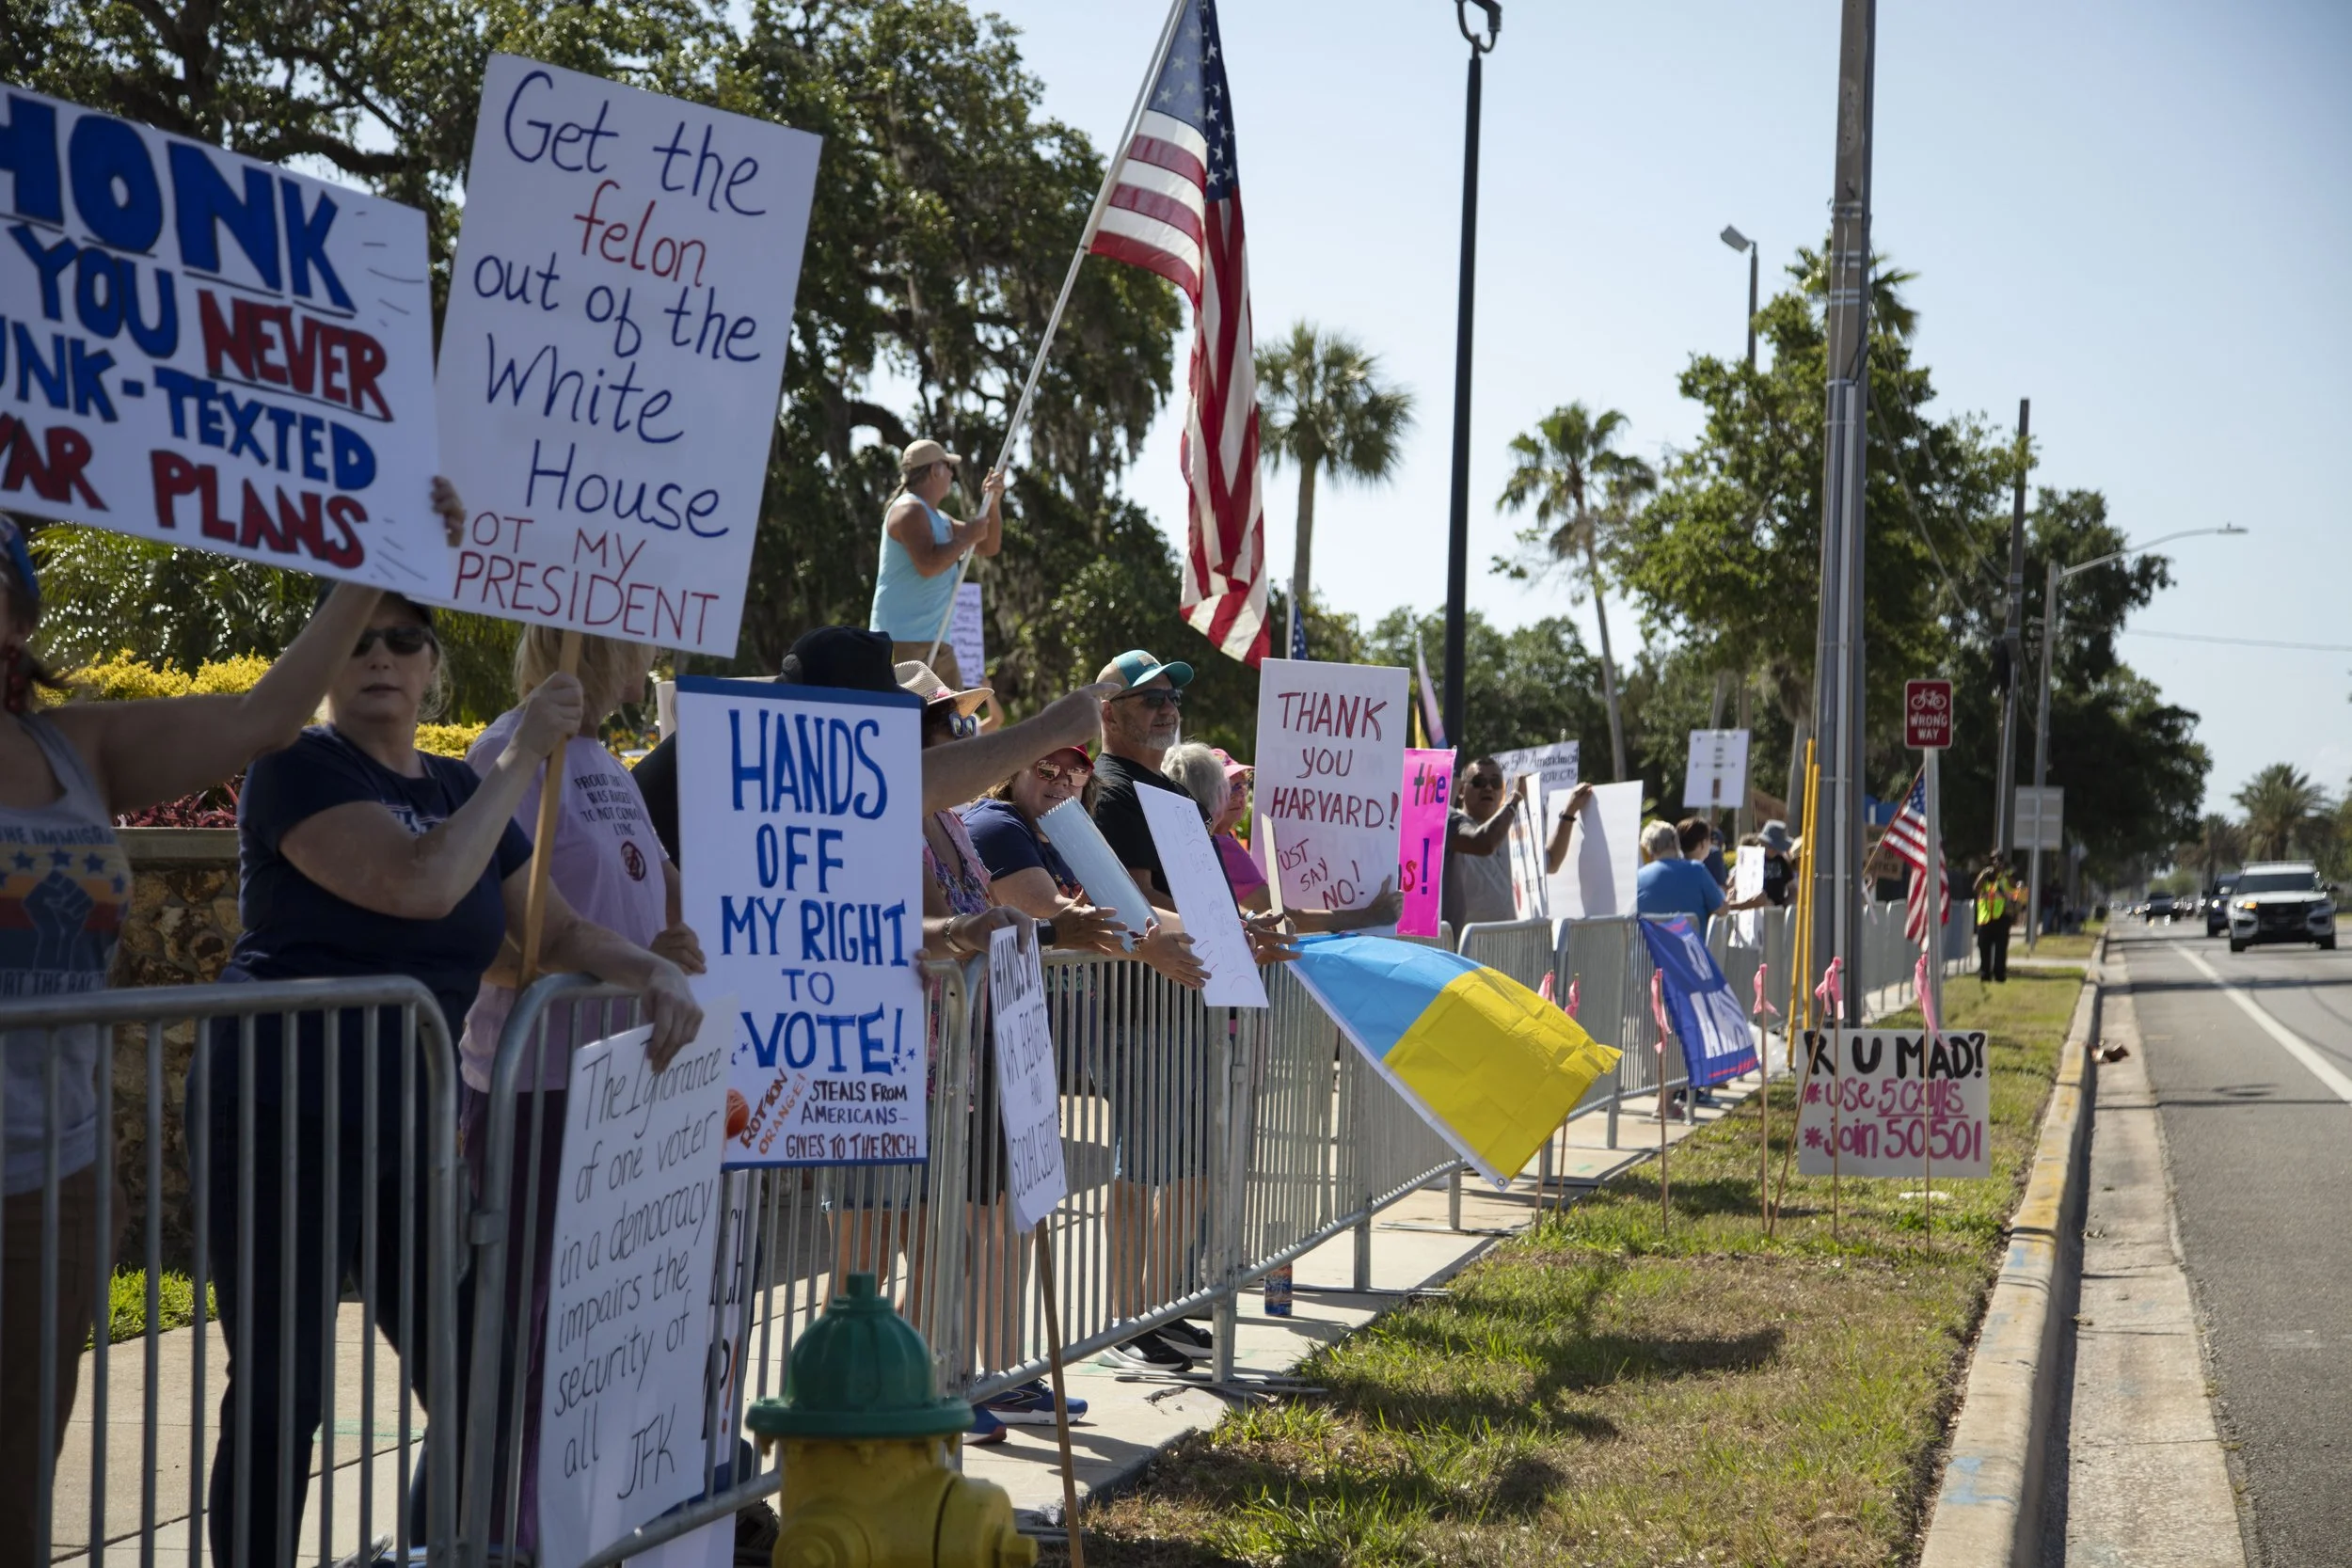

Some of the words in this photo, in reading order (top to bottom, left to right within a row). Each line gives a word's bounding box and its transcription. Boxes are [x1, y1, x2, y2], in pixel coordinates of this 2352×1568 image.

[503, 71, 619, 173] Get
[654, 121, 766, 215] the
[575, 180, 707, 287] felon
[7, 224, 180, 358] YOU
[197, 289, 393, 421] NEVER
[474, 253, 560, 310] out
[586, 286, 642, 358] of
[665, 287, 760, 361] the
[486, 334, 684, 442] White
[0, 411, 111, 513] AR
[150, 449, 368, 569] PLANS
[527, 440, 728, 538] House
[472, 512, 534, 553] OT
[573, 528, 646, 585] MY
[453, 551, 719, 645] PRESIDENT
[1278, 691, 1388, 741] THANK
[1910, 712, 1947, 727] WRONG
[1917, 728, 1939, 740] WAY
[574, 773, 608, 789] PROUD
[729, 709, 887, 819] HANDS
[1296, 747, 1353, 779] YOU
[1413, 763, 1445, 806] the
[1540, 768, 1577, 784] ROTECTS
[1271, 787, 1399, 830] HARVARD!
[756, 824, 844, 893] OFF
[1278, 838, 1309, 871] UST
[1300, 857, 1327, 893] SAY
[1322, 860, 1365, 910] NO!
[721, 895, 786, 956] MY
[801, 898, 909, 967] RIGHT
[782, 968, 834, 1006] TO
[740, 1003, 904, 1076] VOTE!
[1001, 1023, 1020, 1088] VA
[1804, 1030, 1836, 1076] R
[1851, 1036, 1882, 1075] U
[1896, 1032, 1986, 1079] MAD?
[582, 1048, 627, 1131] The
[626, 1037, 722, 1140] Ignorance
[759, 1072, 810, 1155] ORANGE!
[809, 1080, 866, 1102] STEALS
[871, 1083, 908, 1102] FROM
[576, 1140, 603, 1204] of
[609, 1147, 644, 1191] one
[658, 1110, 717, 1173] voter
[787, 1134, 825, 1159] GIVES
[829, 1133, 846, 1160] TO
[1884, 1118, 1981, 1163] 50501
[561, 1235, 580, 1290] in
[587, 1230, 600, 1271] a
[610, 1179, 714, 1261] democracy
[559, 1275, 642, 1362] impairs
[654, 1246, 690, 1302] the
[554, 1324, 655, 1417] security
[666, 1289, 692, 1352] of
[565, 1401, 599, 1479] all
[617, 1402, 675, 1499] JFK
